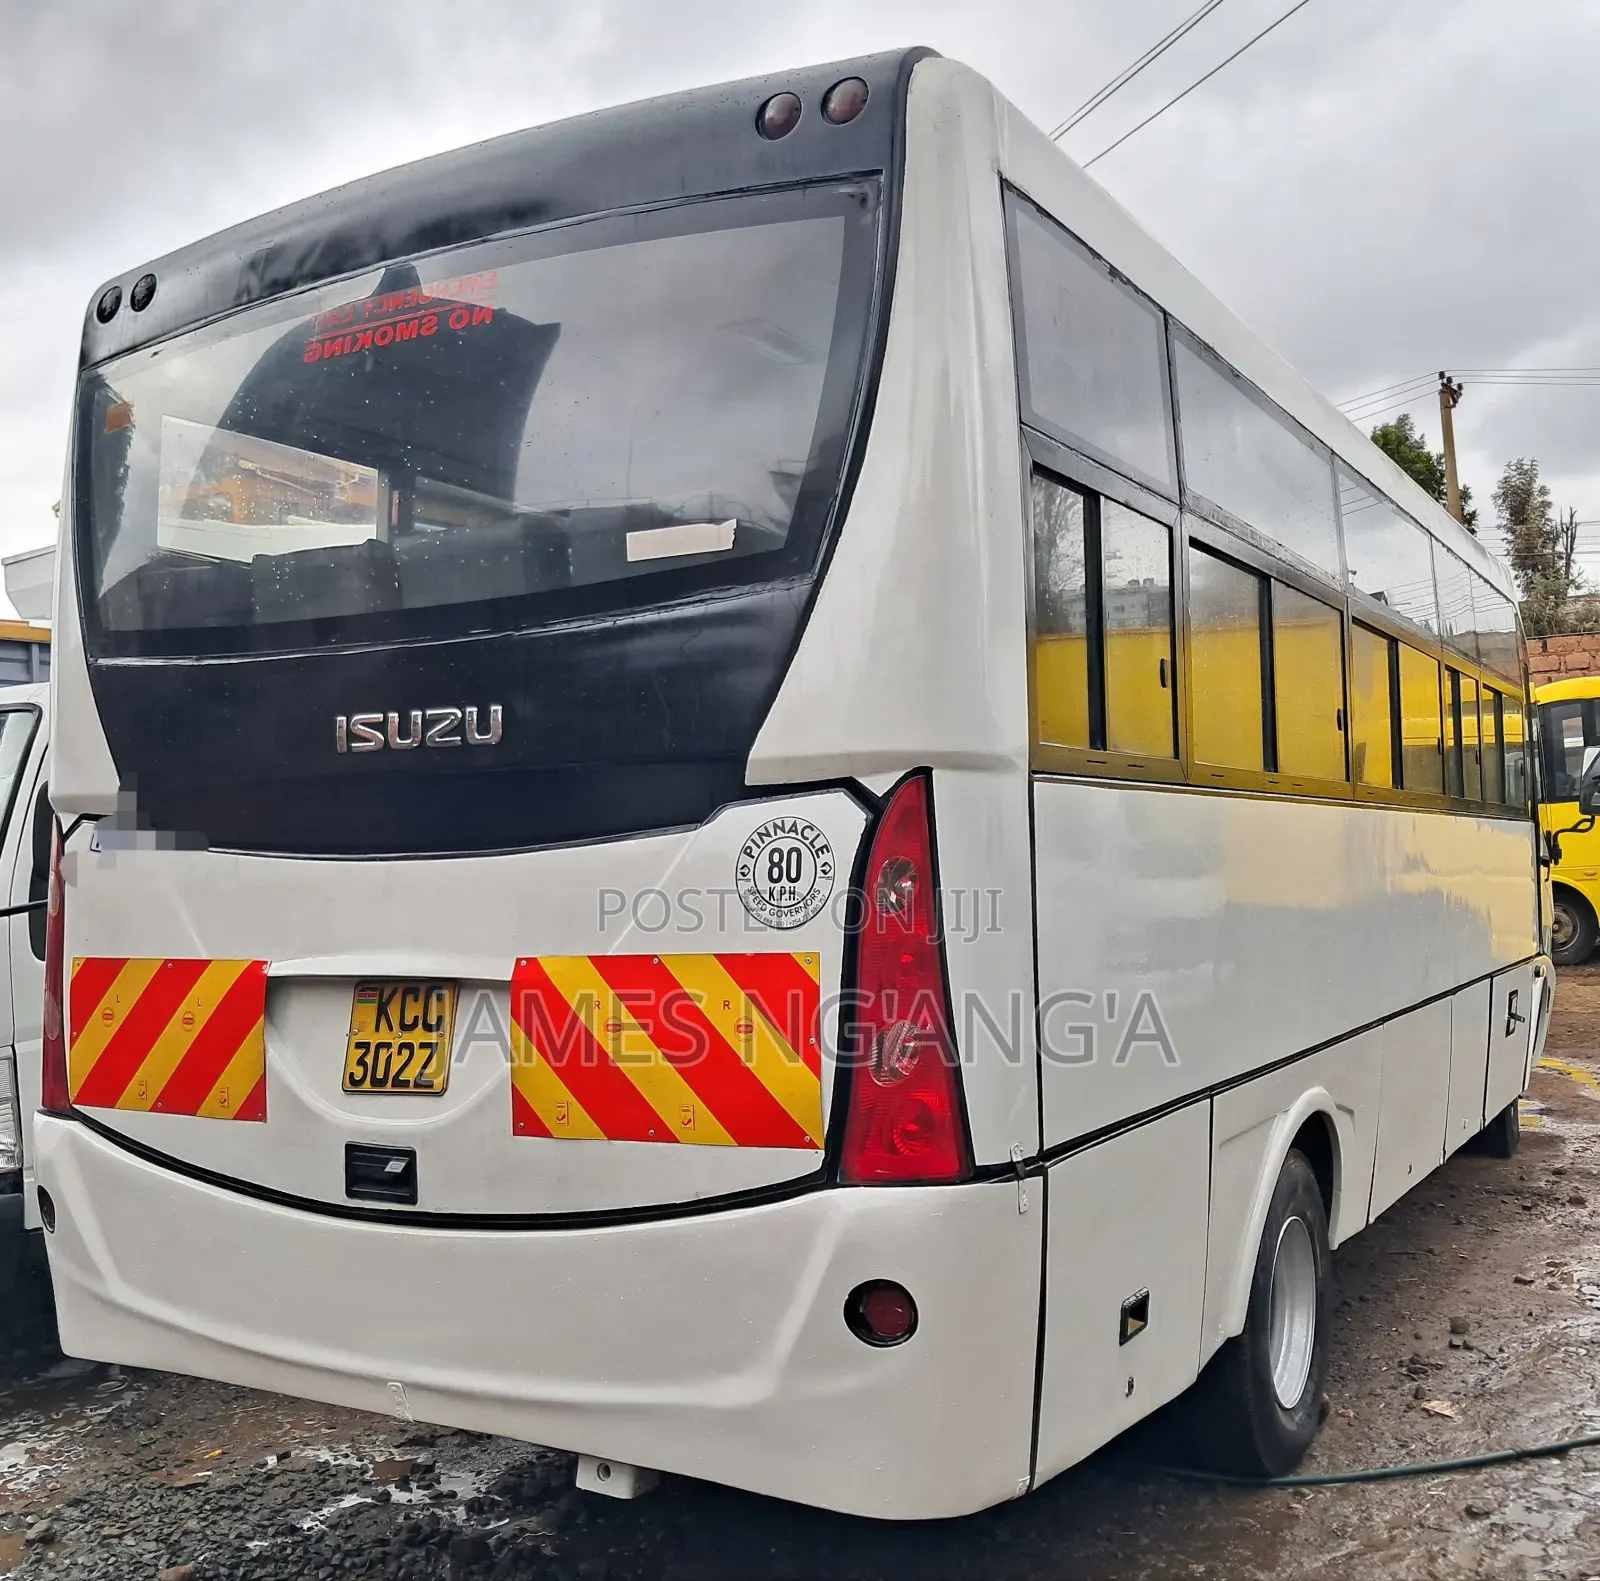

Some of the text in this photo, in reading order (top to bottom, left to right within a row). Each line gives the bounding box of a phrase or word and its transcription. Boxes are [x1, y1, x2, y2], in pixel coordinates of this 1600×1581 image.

[336, 705, 502, 753] ISUZU
[743, 819, 830, 859] PINNACLE
[767, 846, 802, 884] 80
[747, 886, 821, 918] SPEED GOVERNORS
[375, 986, 443, 1032] KCC
[593, 1000, 602, 1011] R
[722, 1000, 731, 1011] R
